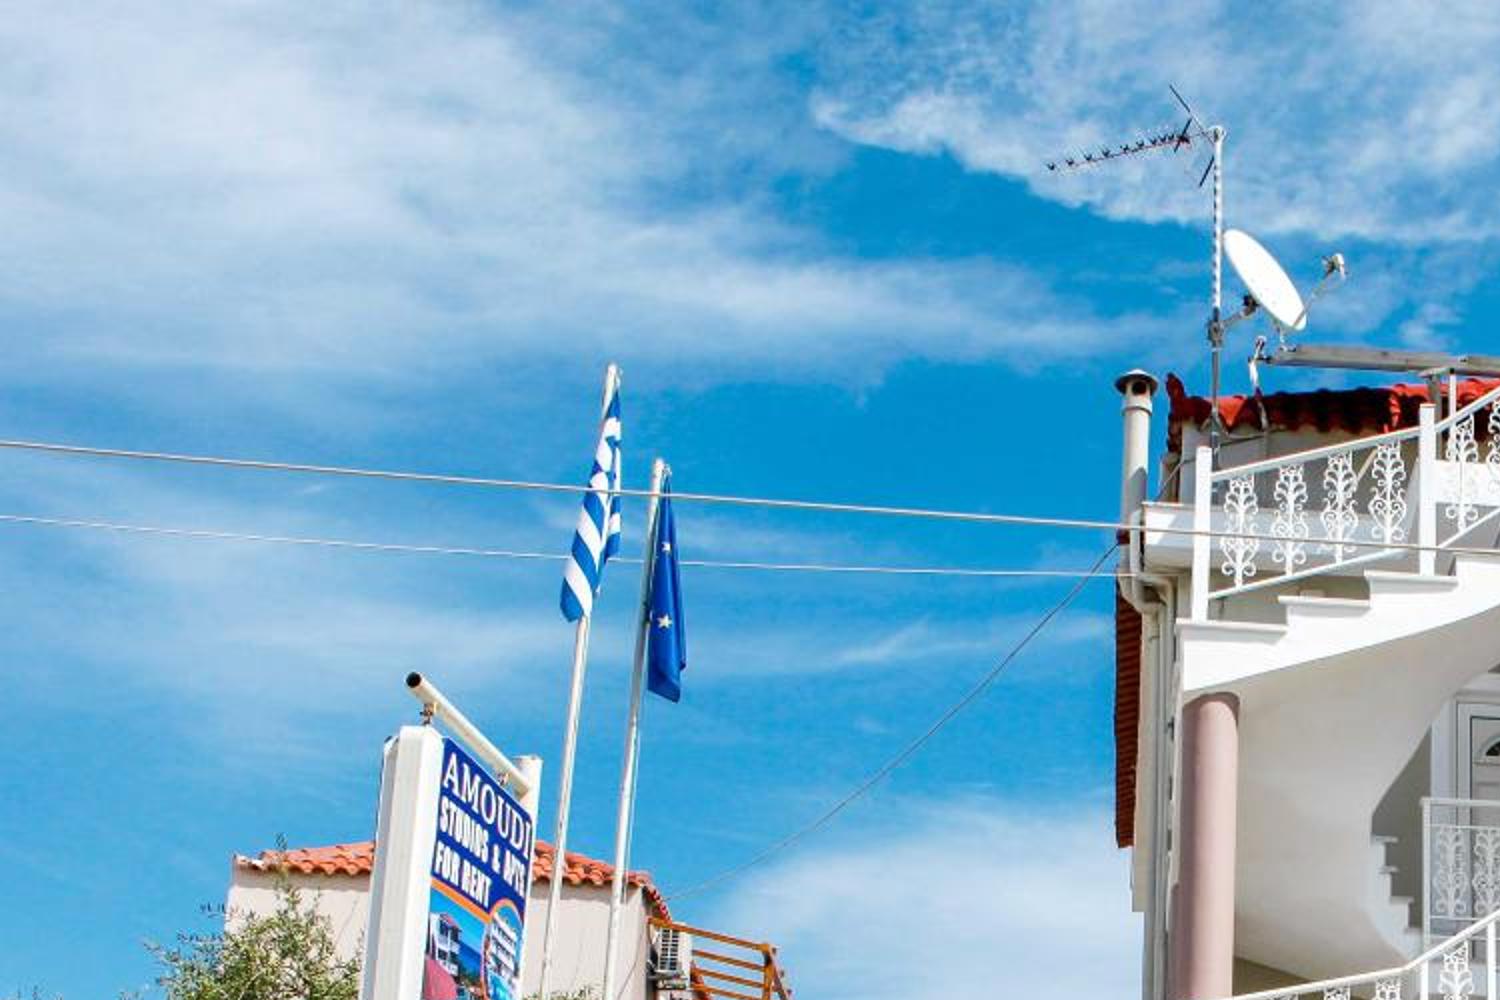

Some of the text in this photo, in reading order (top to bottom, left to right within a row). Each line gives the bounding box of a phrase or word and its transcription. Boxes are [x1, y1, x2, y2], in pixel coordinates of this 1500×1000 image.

[440, 795, 489, 863] STUDIOS
[443, 752, 531, 861] AMOUDI
[434, 840, 492, 909] FOR RENT
